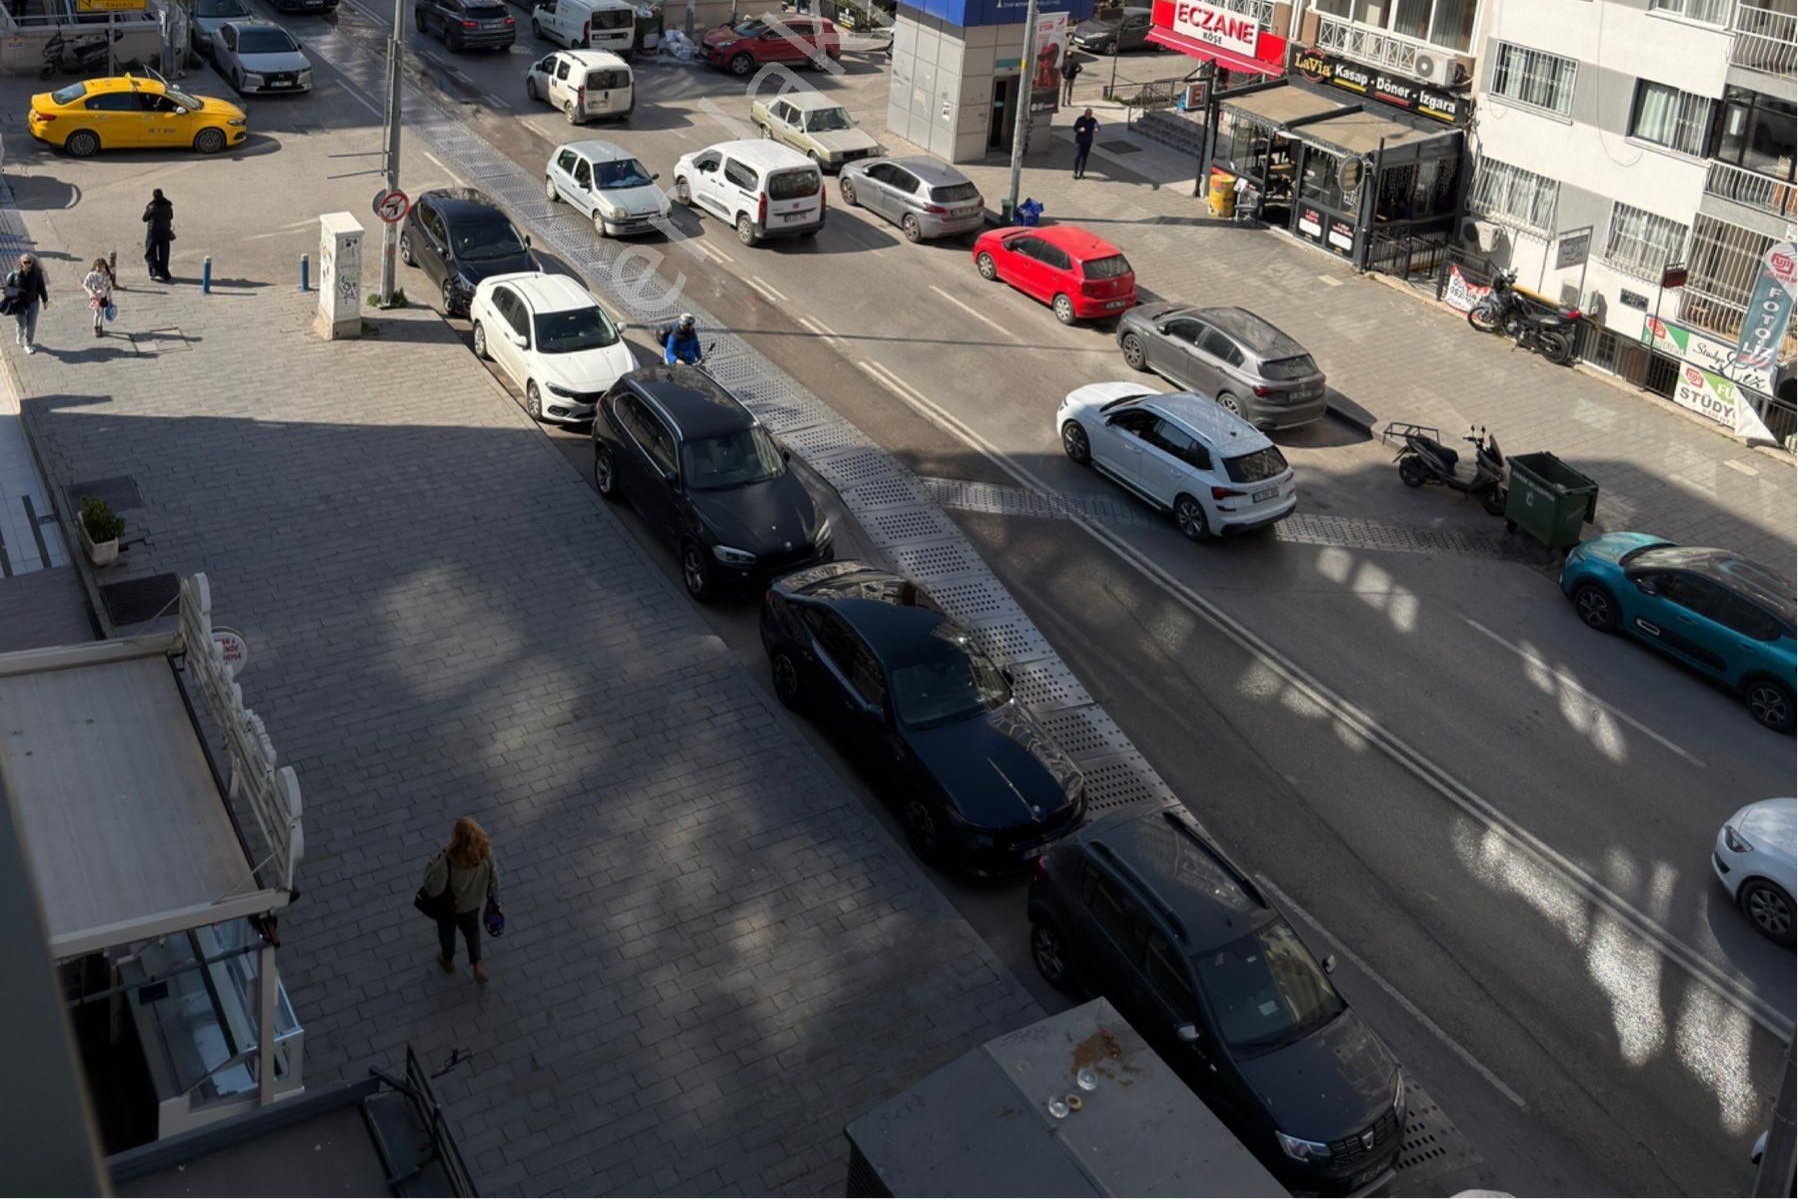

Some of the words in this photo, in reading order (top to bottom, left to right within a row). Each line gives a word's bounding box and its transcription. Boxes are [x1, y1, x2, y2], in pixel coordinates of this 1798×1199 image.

[1177, 2, 1255, 45] ECZANE
[1202, 31, 1223, 45] KÖSE
[1294, 53, 1332, 77] LaVia
[1335, 63, 1368, 87] Kasap
[1376, 76, 1412, 99] Döner
